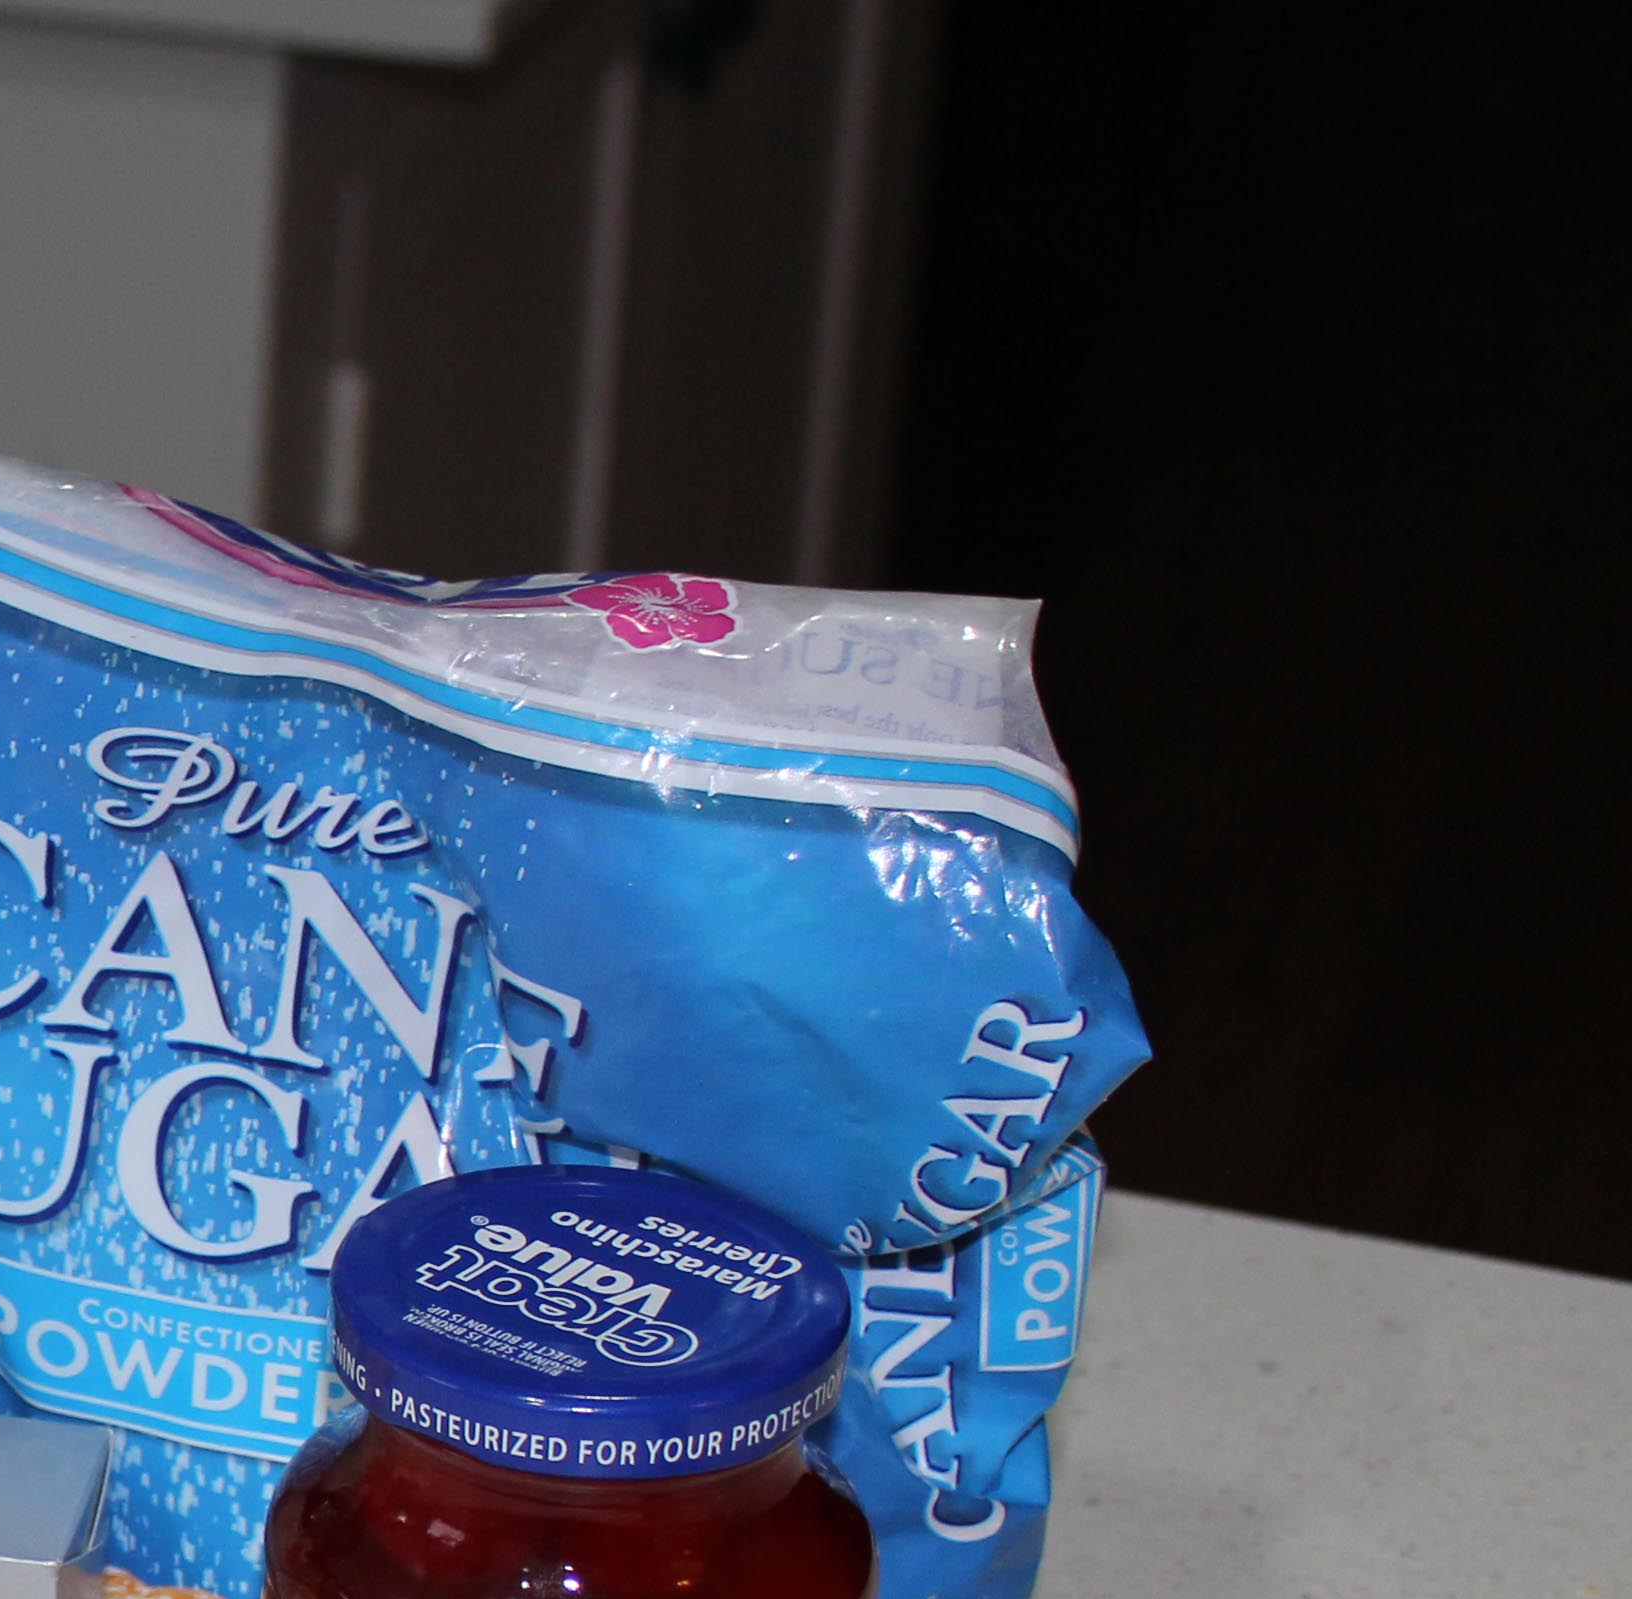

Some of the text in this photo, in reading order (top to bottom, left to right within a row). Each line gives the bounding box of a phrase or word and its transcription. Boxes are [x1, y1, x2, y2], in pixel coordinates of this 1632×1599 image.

[84, 726, 428, 858] Pure
[550, 1210, 784, 1302] Maraschino
[637, 1214, 805, 1280] Cherries
[473, 1222, 673, 1320] Value
[414, 1242, 700, 1369] Great
[427, 1303, 451, 1317] UP.
[448, 1313, 468, 1325] IS
[466, 1318, 523, 1345] BUTTON
[466, 1330, 520, 1355] SEAL IS
[519, 1340, 537, 1352] IF
[535, 1345, 588, 1369] REJECT
[390, 1358, 846, 1466] PASTEURIZED FOR YOUR PROTECTION
